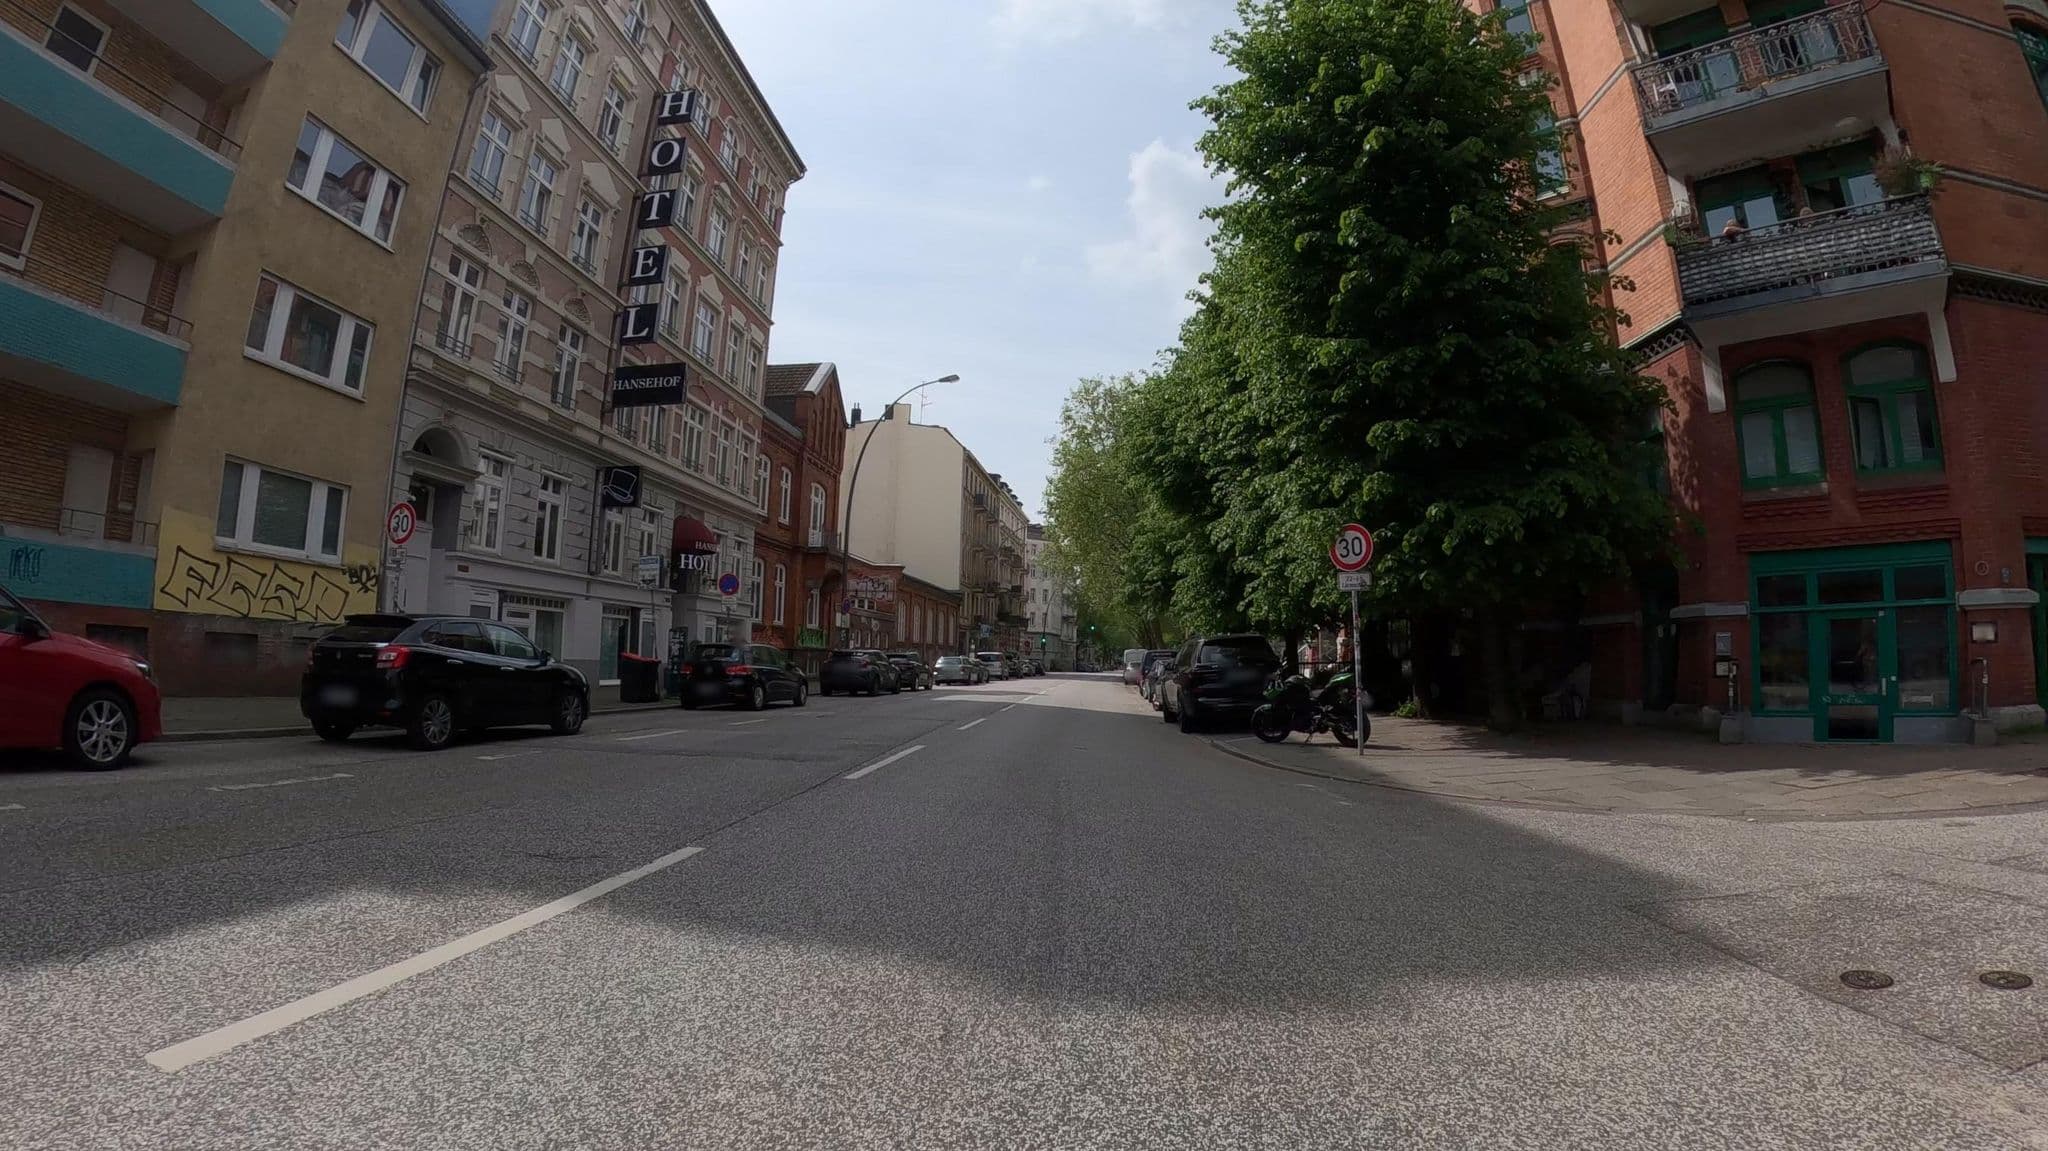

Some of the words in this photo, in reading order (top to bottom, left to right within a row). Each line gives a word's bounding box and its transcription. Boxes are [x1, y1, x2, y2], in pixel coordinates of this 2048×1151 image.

[622, 91, 691, 340] HOTEL
[612, 376, 682, 391] HANSEHOF
[393, 514, 409, 533] 30
[1338, 536, 1363, 558] 30
